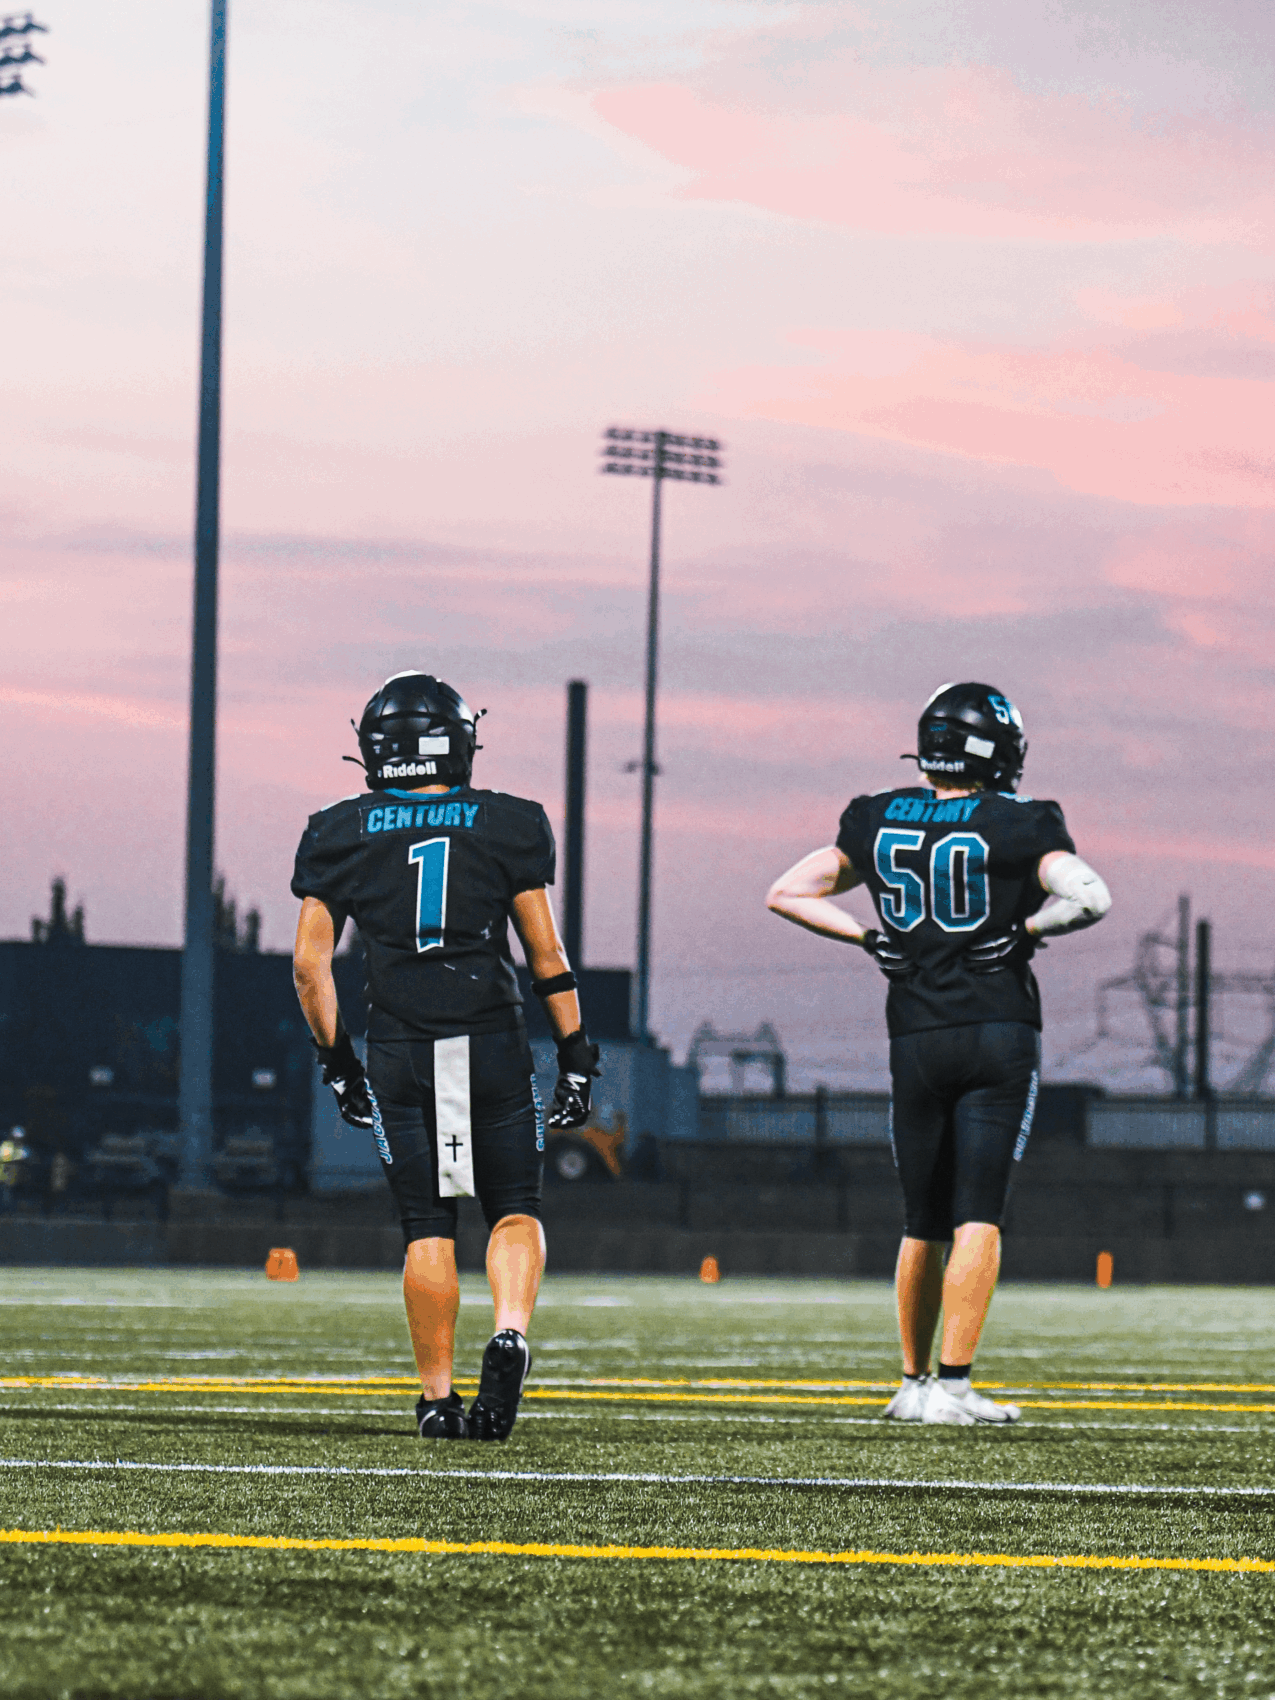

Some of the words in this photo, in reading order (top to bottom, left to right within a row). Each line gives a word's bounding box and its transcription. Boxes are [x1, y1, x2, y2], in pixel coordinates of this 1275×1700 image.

[383, 761, 437, 778] Riddell
[367, 802, 479, 834] CENTURY
[884, 797, 981, 823] CENTURY
[408, 837, 450, 953] 1
[873, 827, 990, 932] 50
